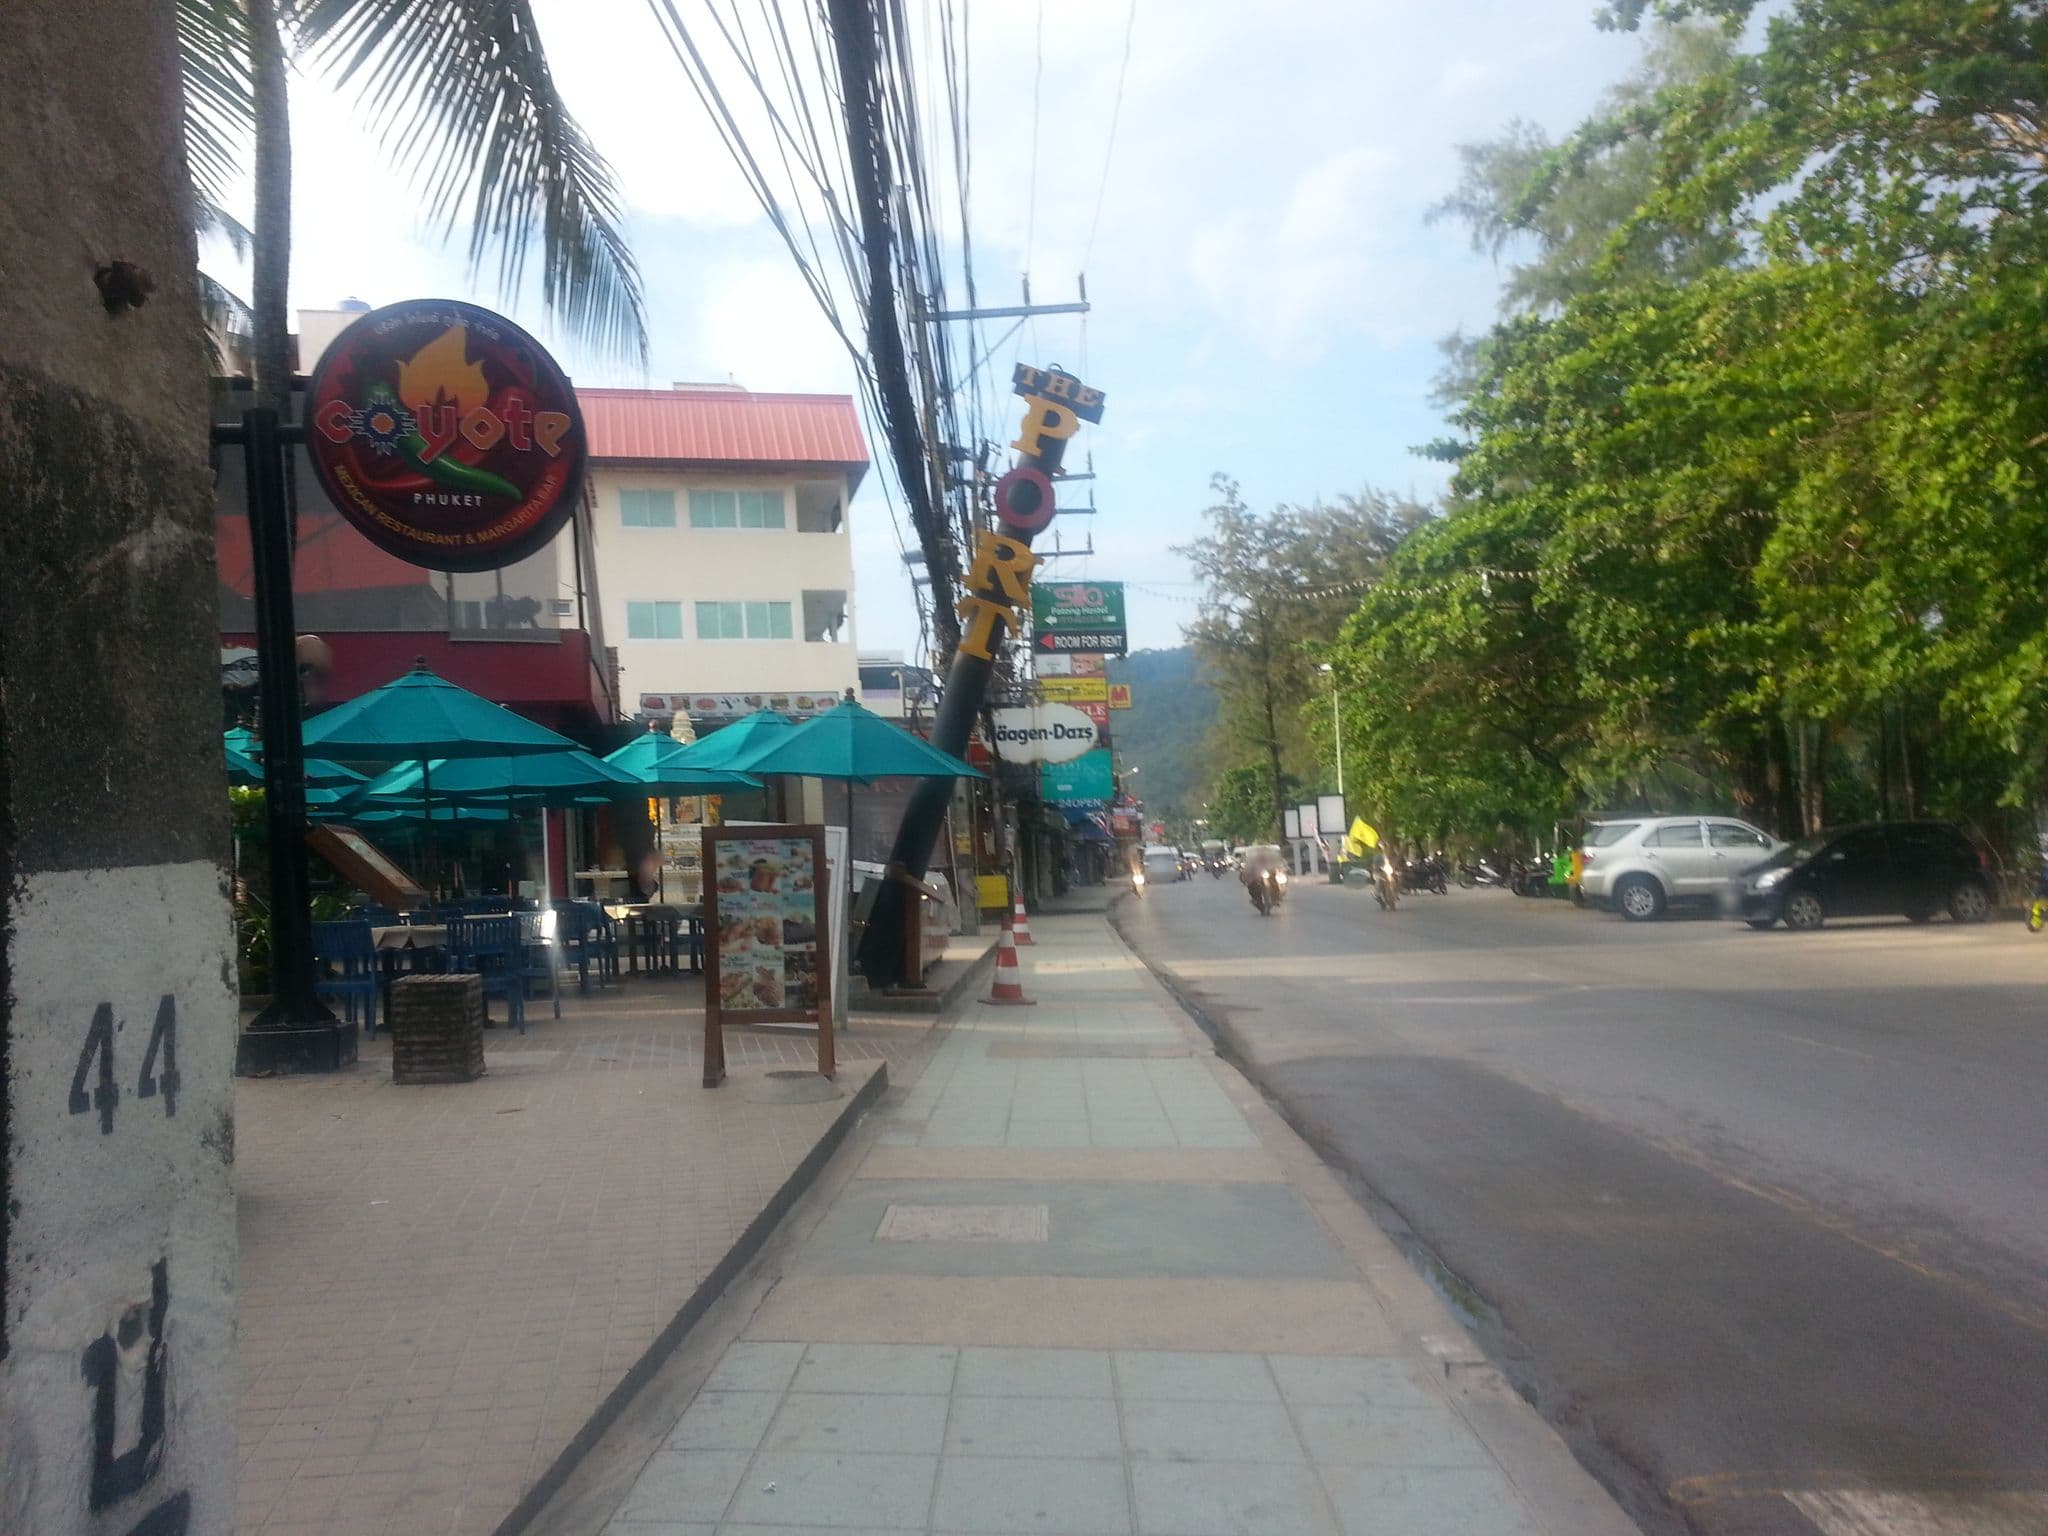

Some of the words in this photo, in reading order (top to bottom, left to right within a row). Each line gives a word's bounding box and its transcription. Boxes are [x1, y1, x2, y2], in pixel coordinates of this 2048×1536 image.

[1020, 366, 1103, 406] THE
[315, 399, 571, 465] Coyote
[334, 465, 376, 516] MEXICAN
[375, 508, 462, 545] RESTAURANT
[466, 534, 475, 544] &
[476, 501, 544, 544] MARGARITA
[413, 492, 483, 507] PHUKET
[1054, 635, 1080, 649] ROOM
[1081, 635, 1100, 649] FOR
[1100, 634, 1123, 648] RENT
[69, 994, 181, 1135] 44
